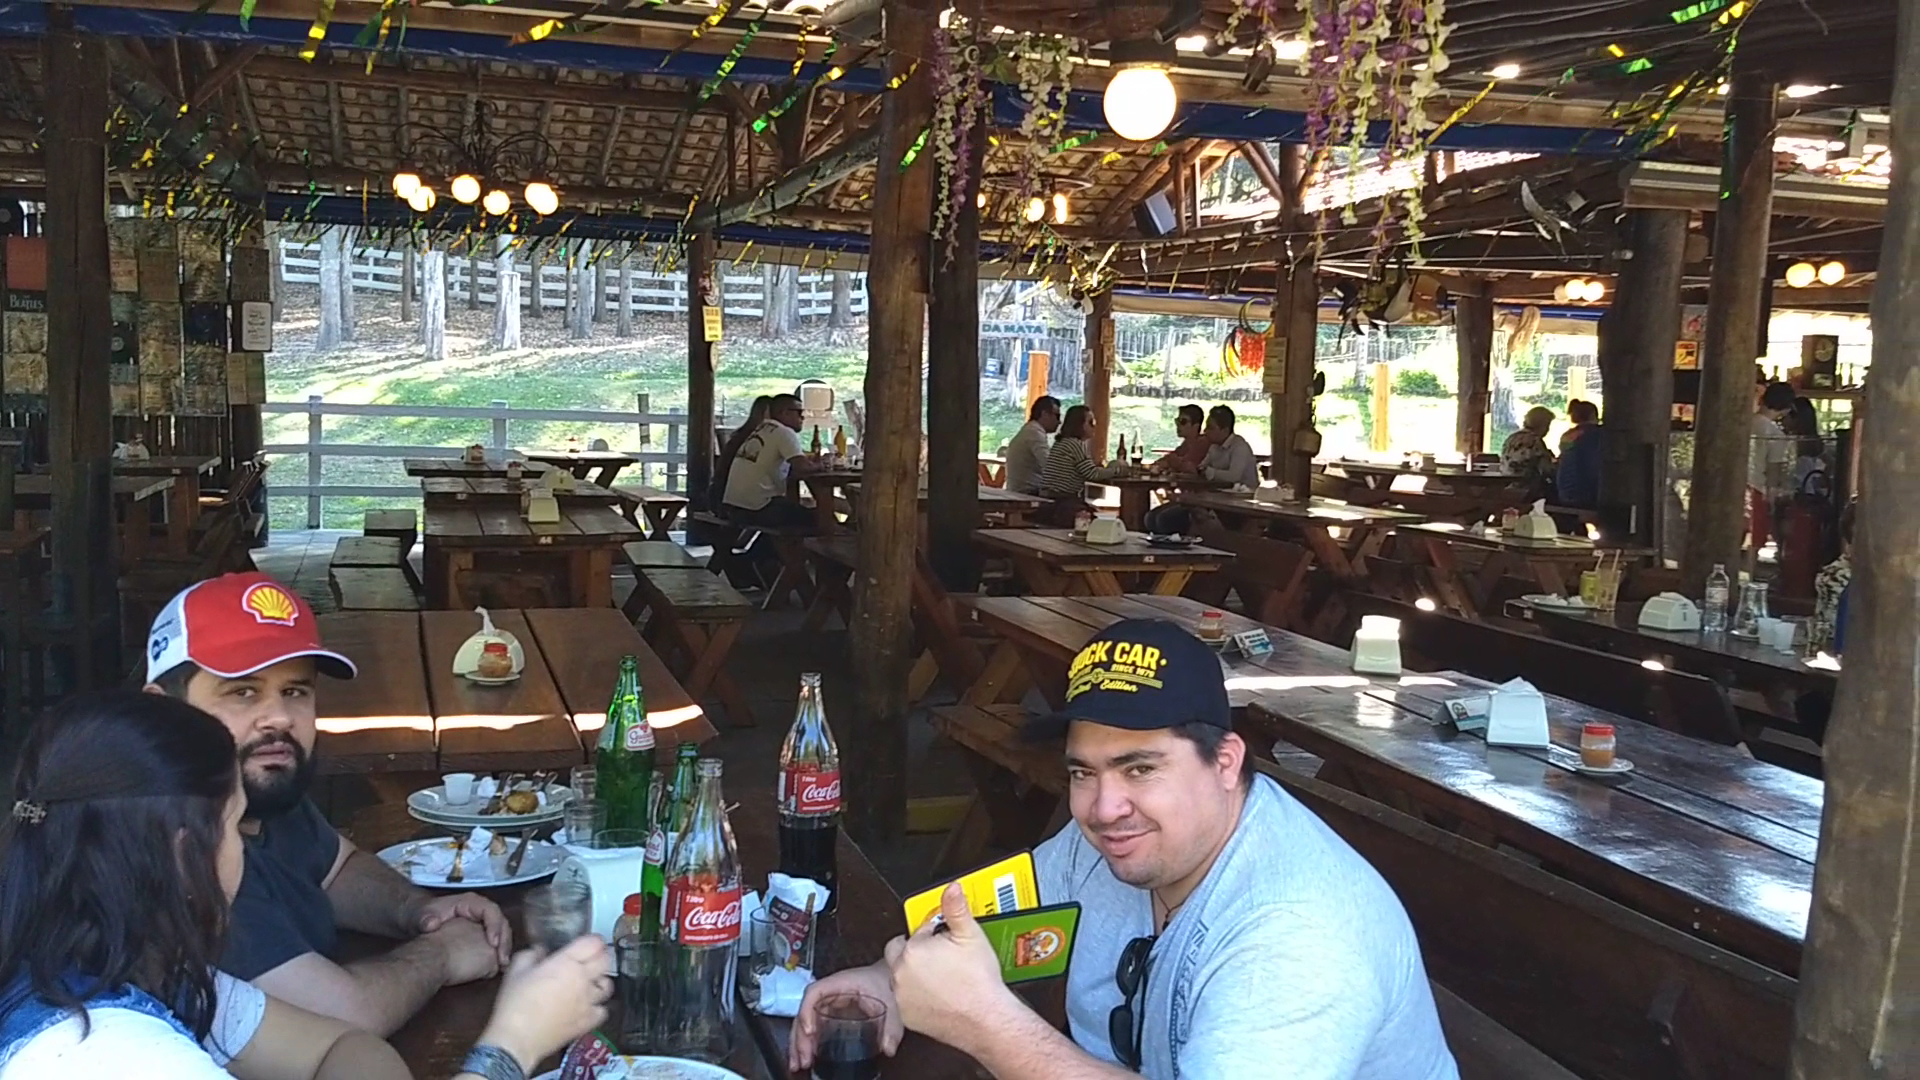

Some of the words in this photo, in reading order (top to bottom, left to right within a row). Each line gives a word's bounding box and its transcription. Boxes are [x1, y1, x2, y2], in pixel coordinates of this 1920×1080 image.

[982, 324, 1001, 332] DA
[1004, 324, 1043, 333] MATA
[1114, 642, 1160, 670] CAR
